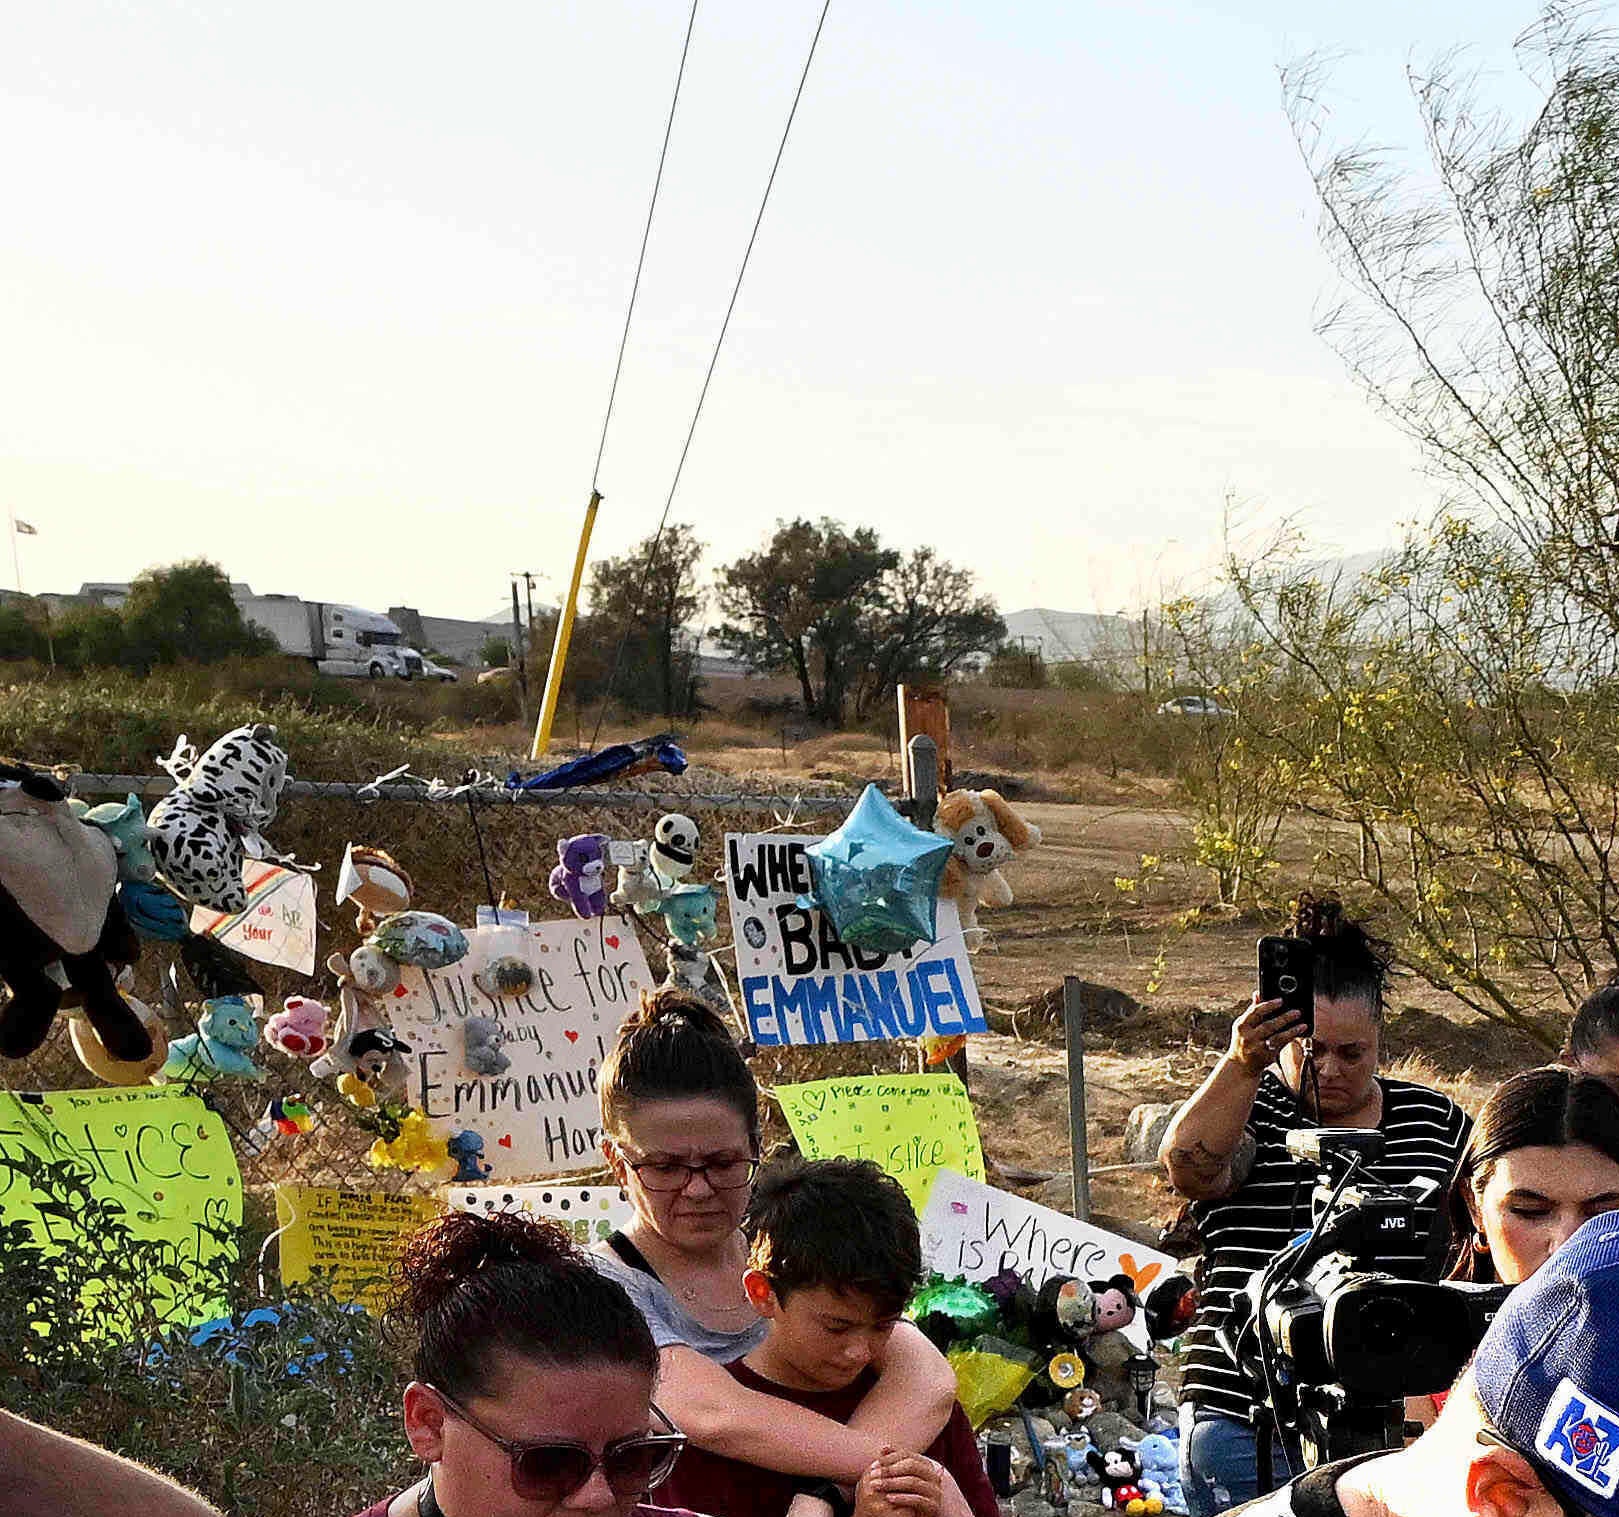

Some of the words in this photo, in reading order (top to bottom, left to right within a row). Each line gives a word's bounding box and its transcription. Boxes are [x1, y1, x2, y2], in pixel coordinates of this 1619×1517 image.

[729, 839, 815, 900] WHE
[574, 938, 632, 1008] for
[743, 958, 987, 1045] EMMANUEL
[544, 1116, 605, 1162] Har
[958, 1232, 984, 1270] is
[985, 1202, 1107, 1276] Where
[1380, 1217, 1406, 1229] JVC
